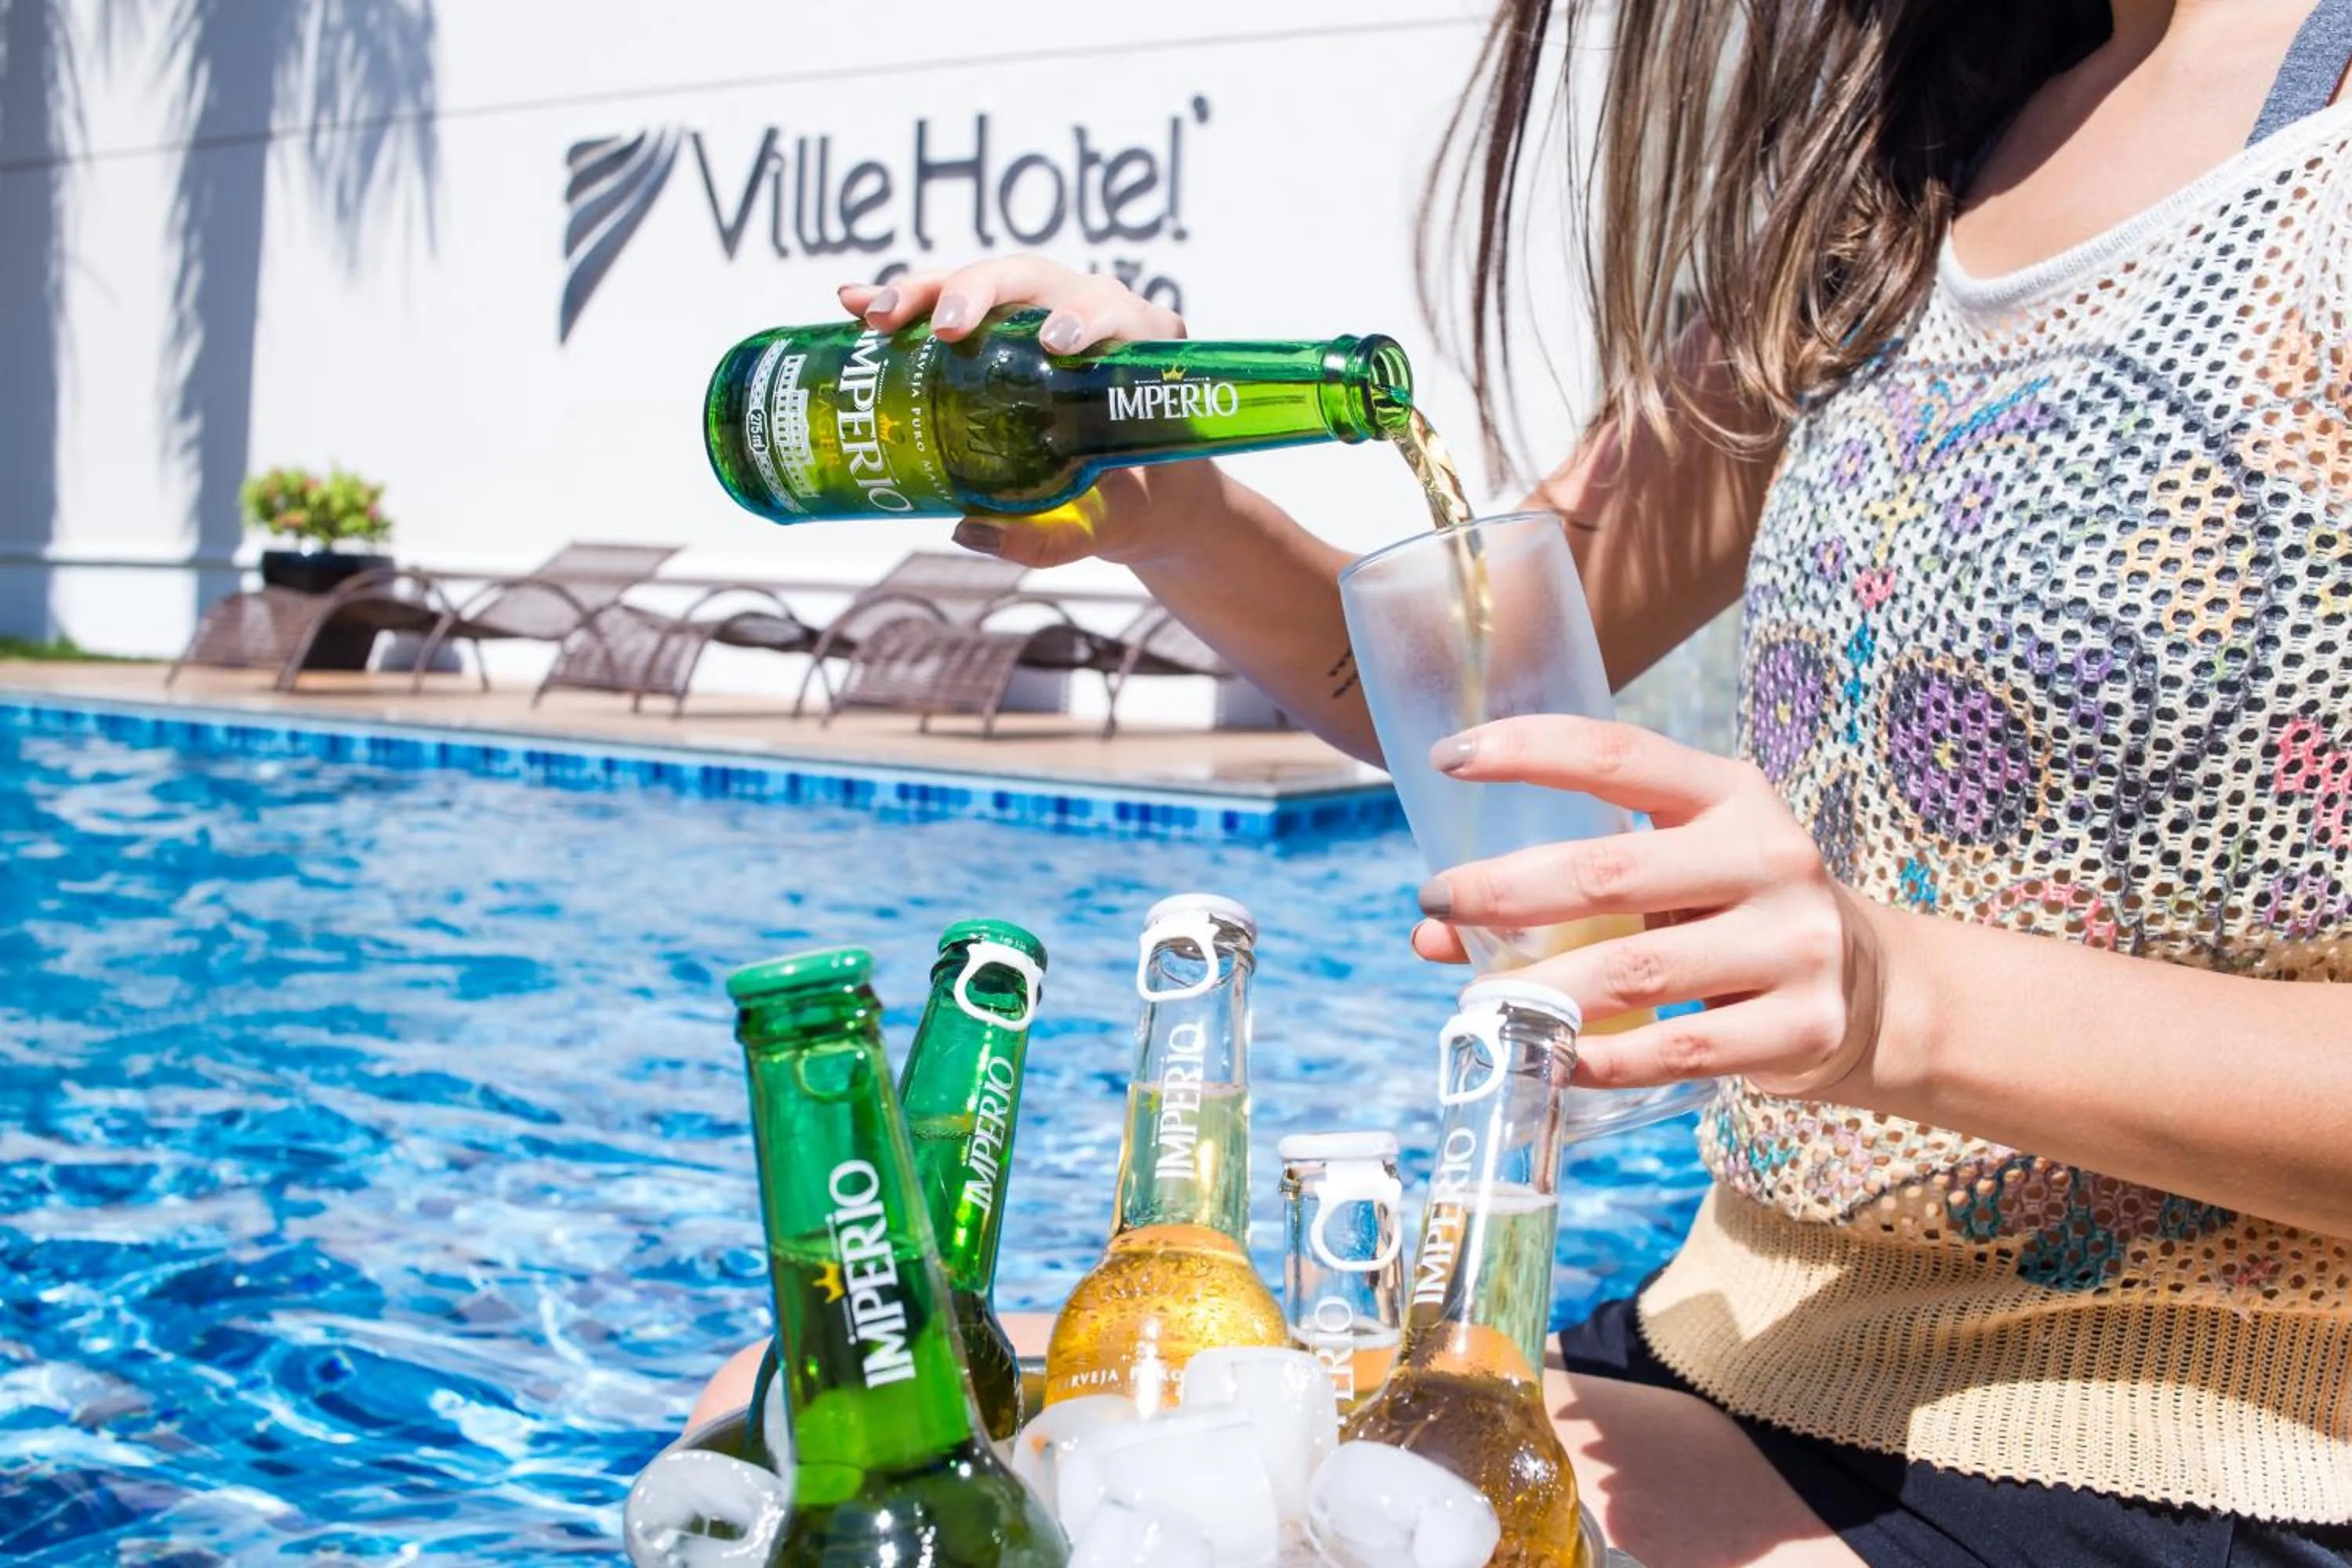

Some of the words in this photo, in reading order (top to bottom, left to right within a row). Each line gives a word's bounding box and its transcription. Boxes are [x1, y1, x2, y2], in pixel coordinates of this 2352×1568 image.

[690, 125, 896, 261] Ville
[750, 412, 764, 435] 275
[818, 382, 841, 467] LAGER
[911, 407, 926, 452] PURO
[1107, 382, 1238, 421] IMPERIO
[828, 1160, 916, 1388] IMPERIO
